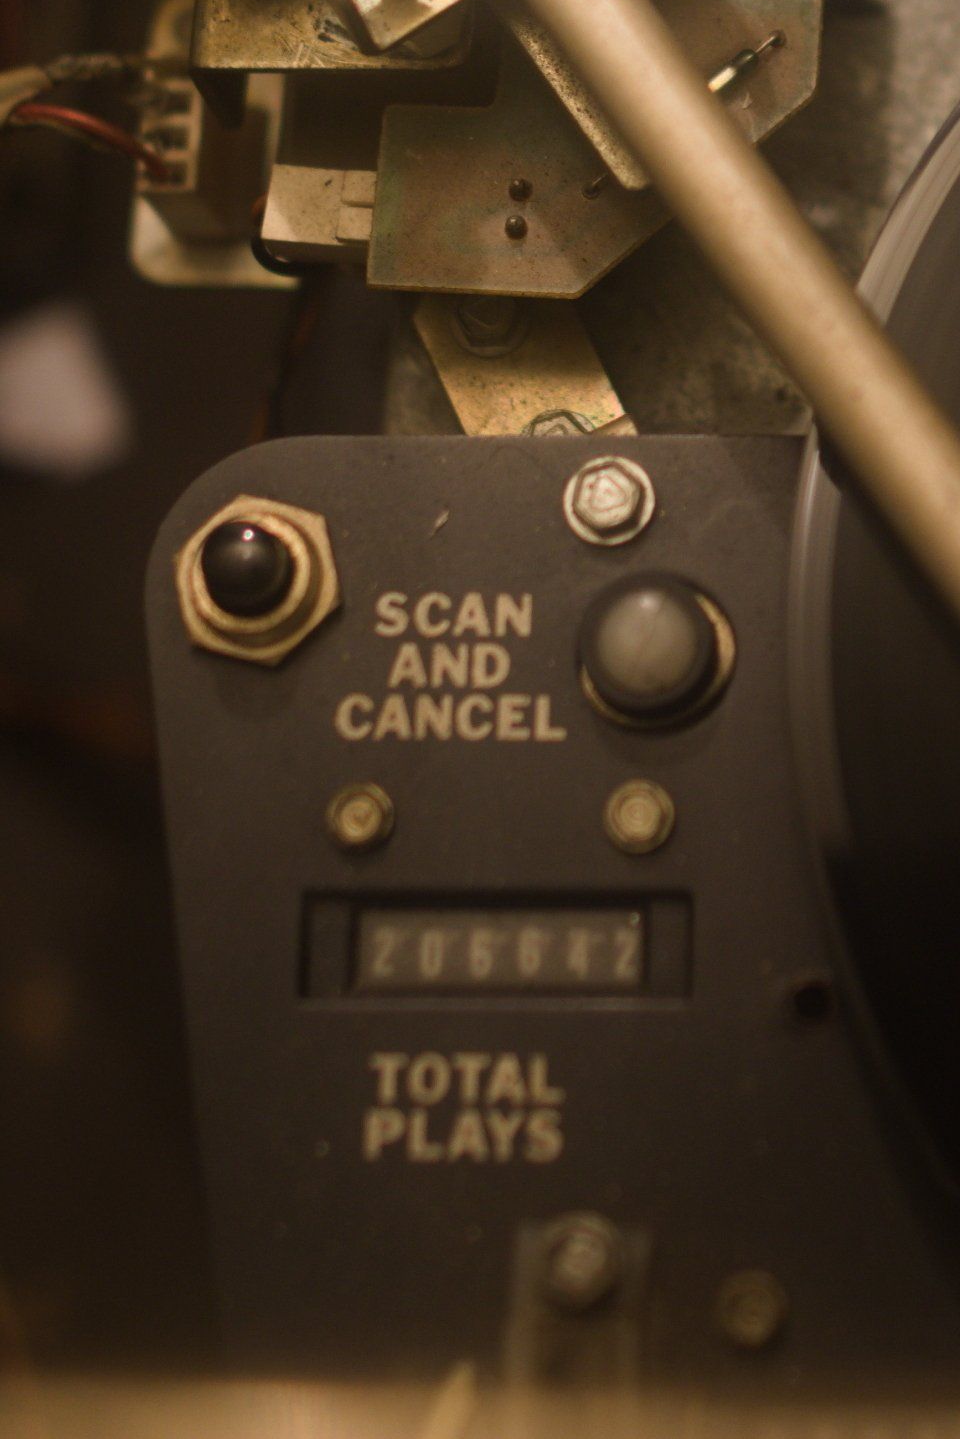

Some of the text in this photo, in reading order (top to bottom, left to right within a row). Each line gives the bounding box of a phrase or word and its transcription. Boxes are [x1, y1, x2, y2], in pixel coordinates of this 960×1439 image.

[375, 592, 533, 637] SCAN
[389, 643, 511, 688] AND
[335, 694, 567, 741] CANCEL
[369, 1052, 564, 1106] TOTAL
[363, 1108, 564, 1161] PLAYS
